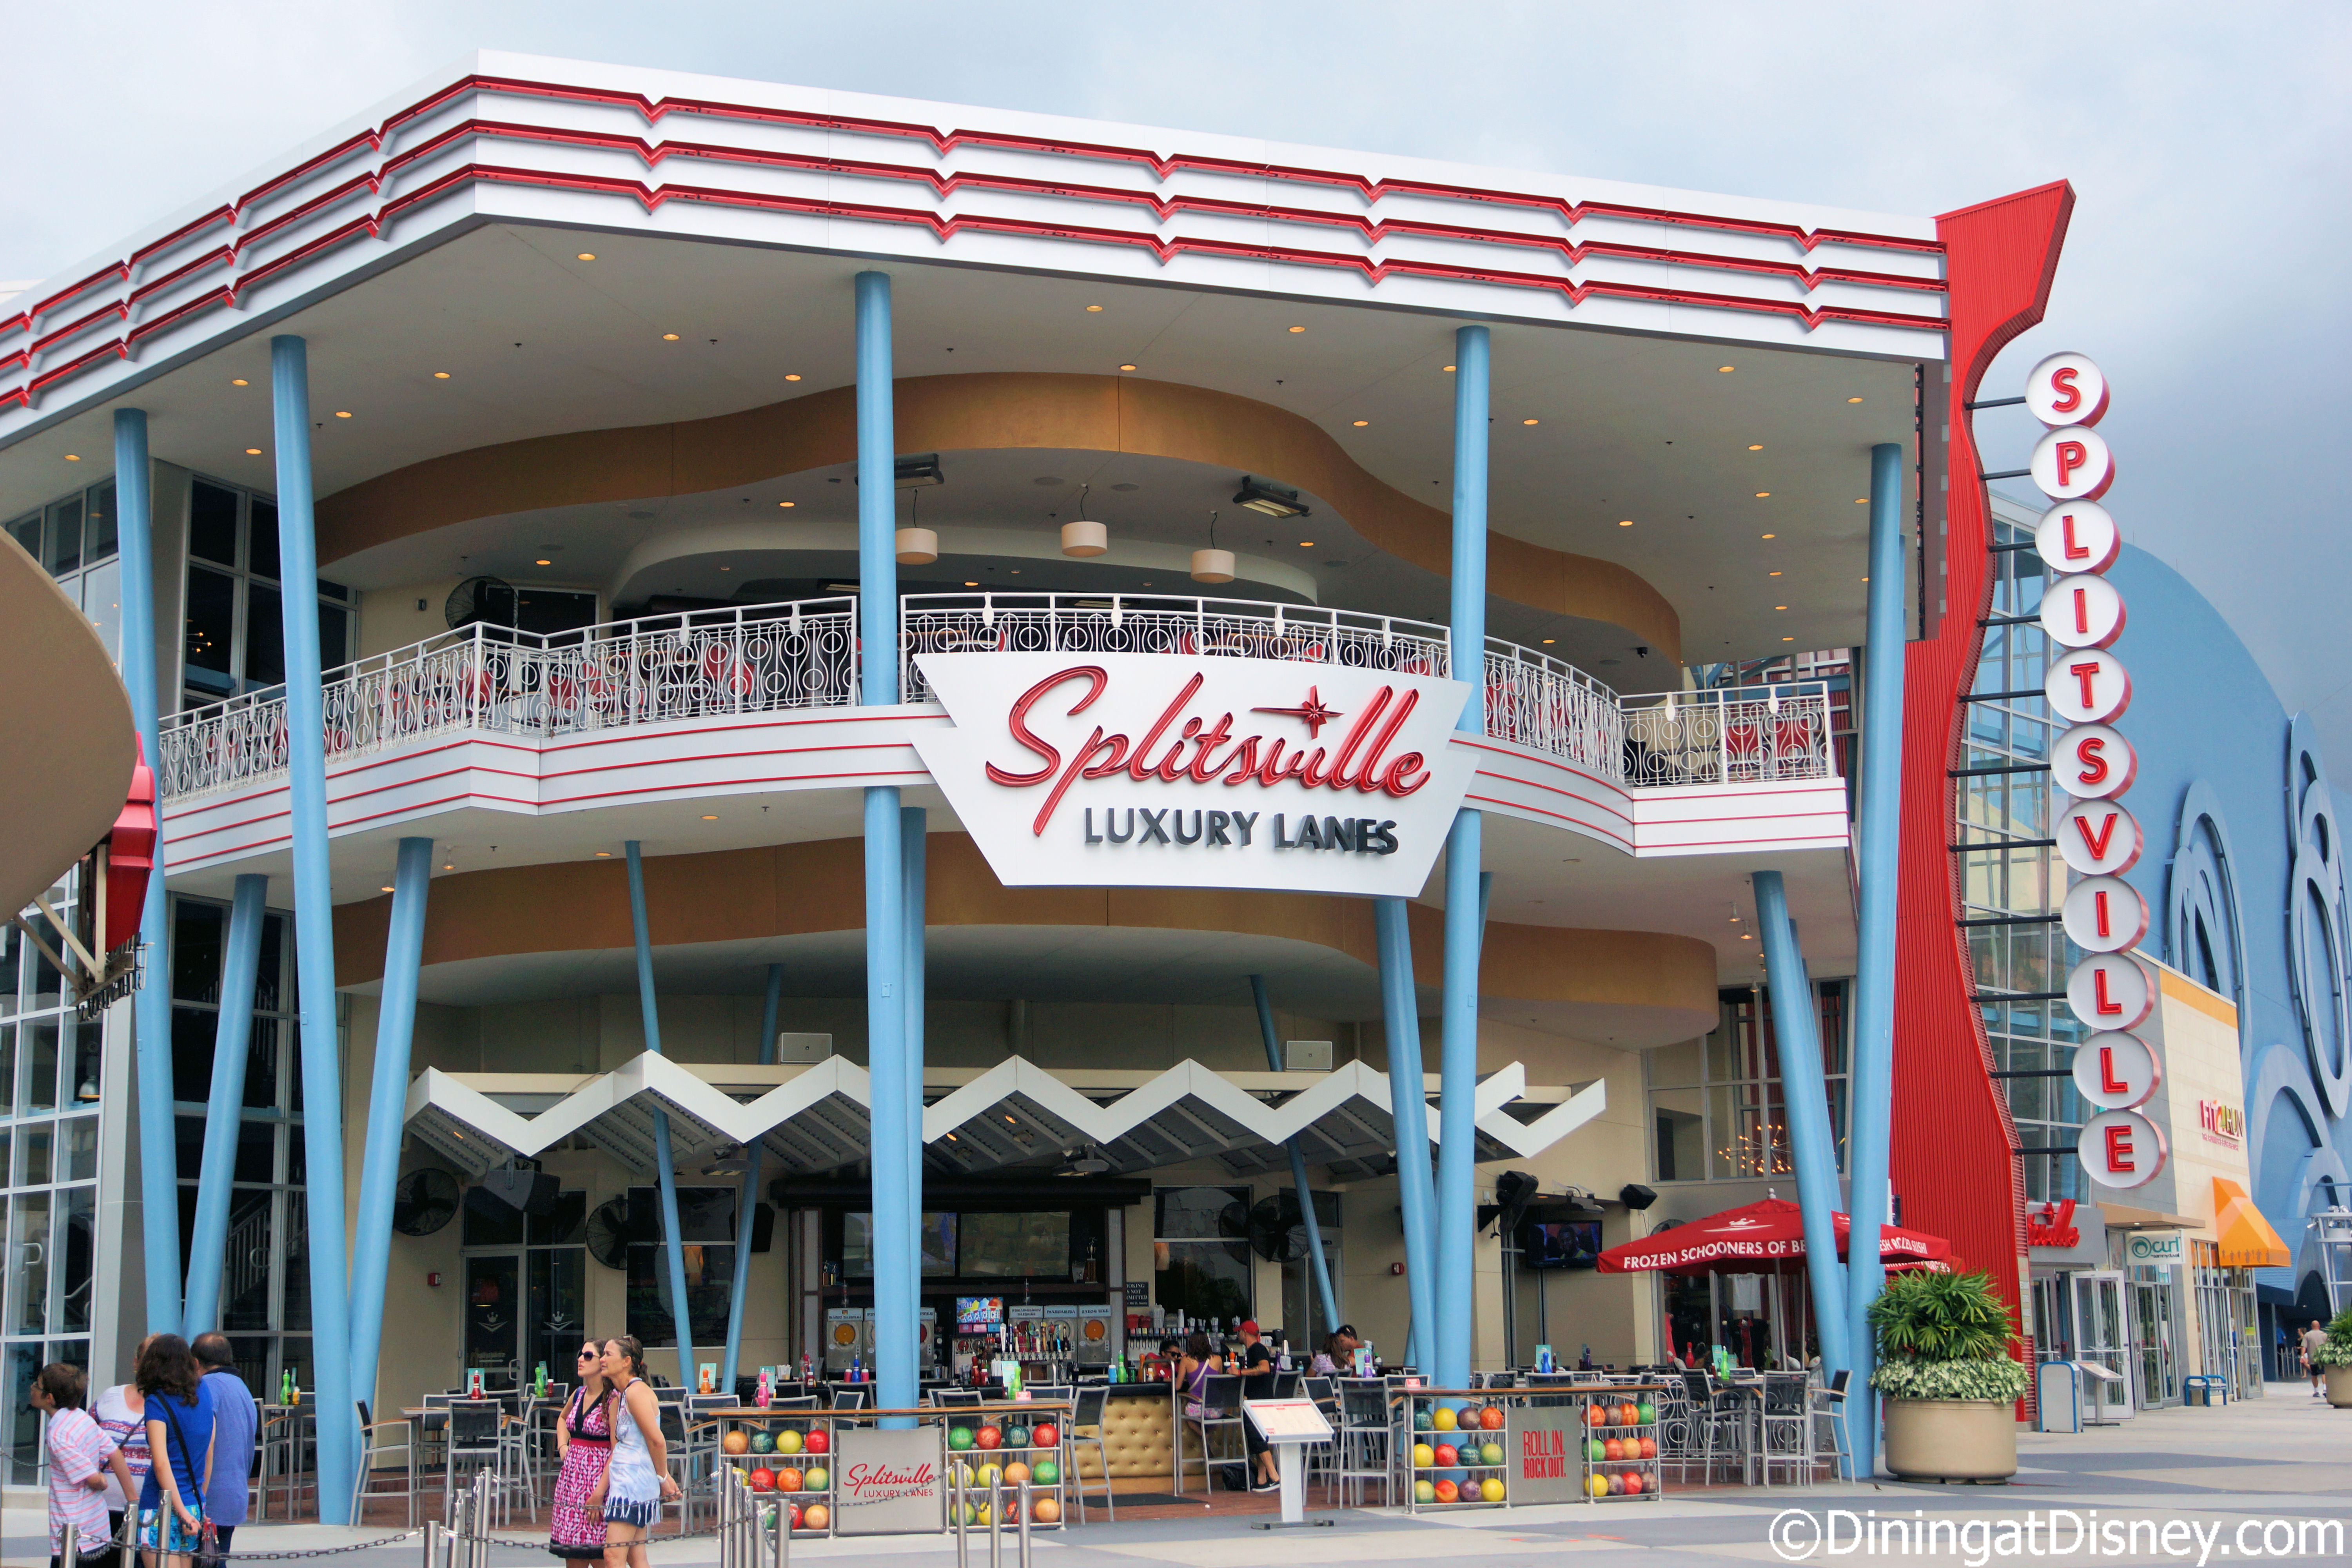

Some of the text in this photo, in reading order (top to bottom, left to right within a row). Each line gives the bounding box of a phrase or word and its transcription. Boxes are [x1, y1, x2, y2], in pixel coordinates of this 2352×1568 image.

[985, 665, 1431, 837] Splitsville
[2051, 367, 2134, 1172] SPLITSVILLE
[1085, 807, 1398, 856] LUXURY LANES
[1624, 1251, 1677, 1269] FROZEN
[1681, 1241, 1763, 1261] SCHOONERS
[1768, 1241, 1786, 1254] OF
[1911, 1240, 1928, 1254] SUSHI
[1523, 1430, 1566, 1456] ROLL IN.
[844, 1463, 934, 1496] Splitsville
[1524, 1456, 1566, 1479] ROCK OUT.
[864, 1489, 900, 1497] LUXURY
